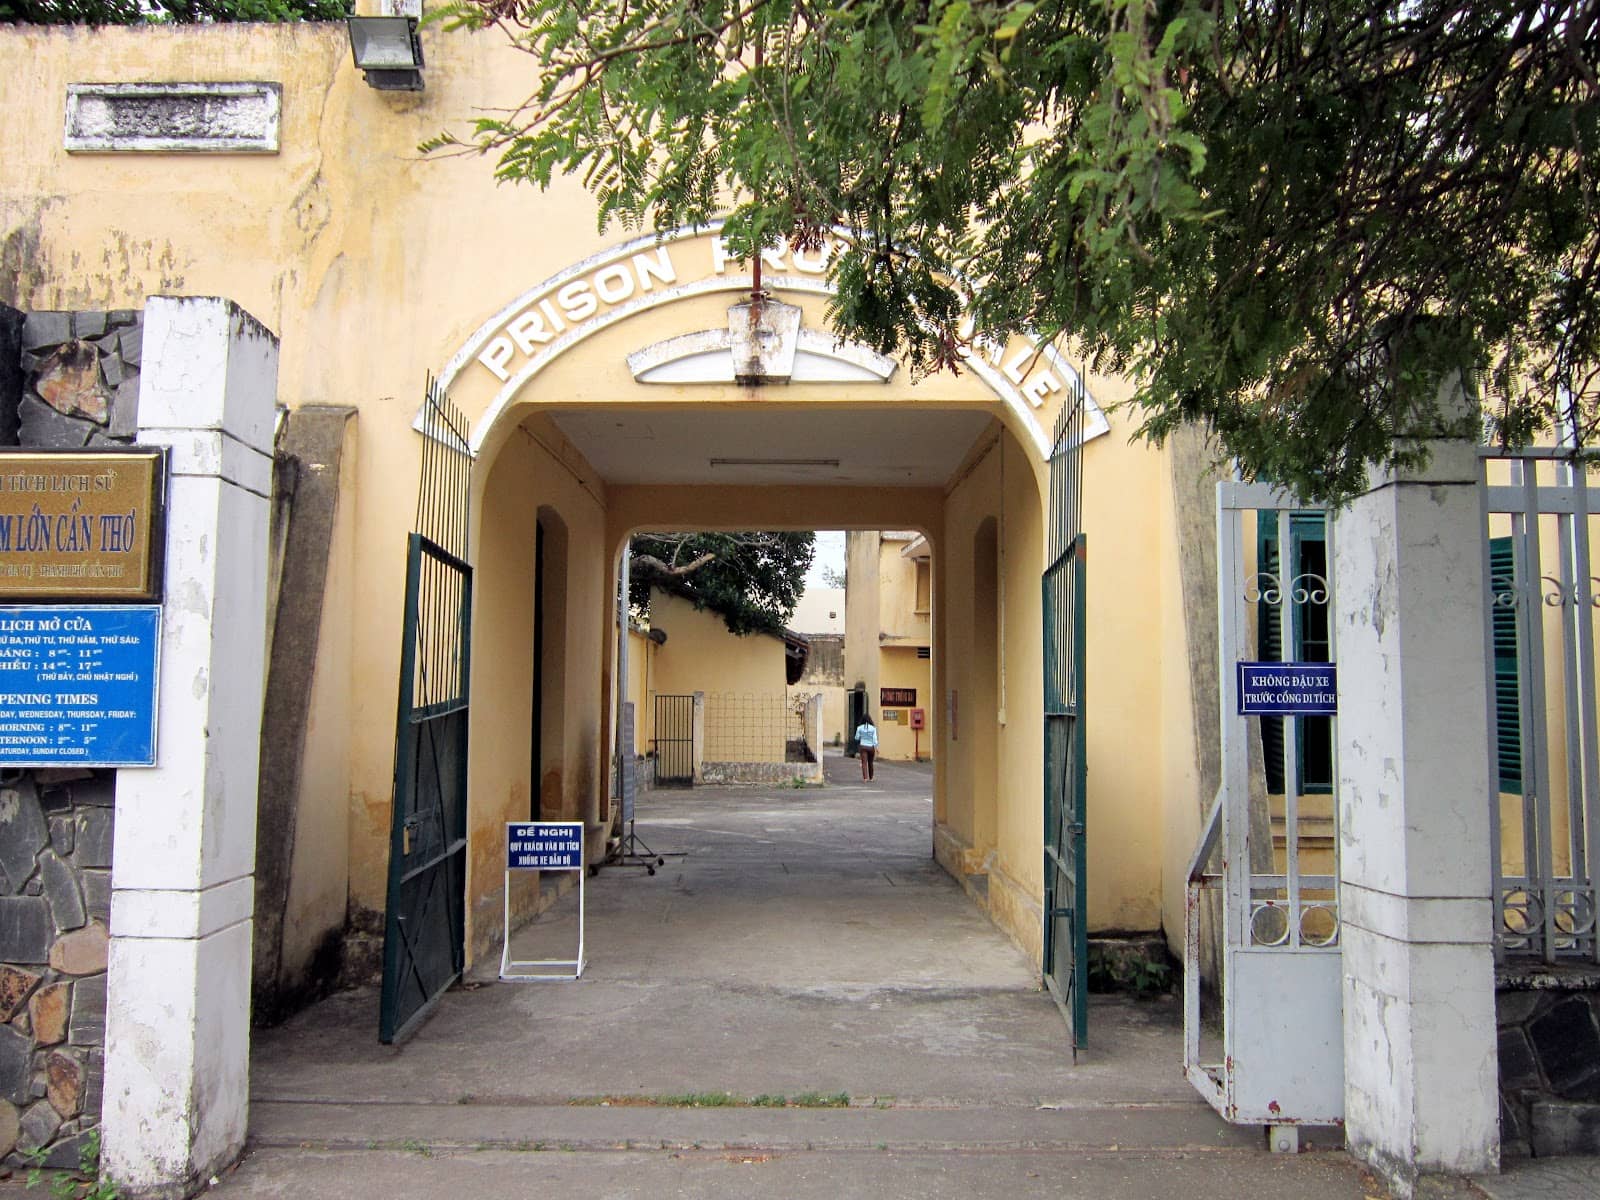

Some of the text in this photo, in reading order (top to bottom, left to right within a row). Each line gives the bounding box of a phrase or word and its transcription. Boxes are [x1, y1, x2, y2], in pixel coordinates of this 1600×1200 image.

[477, 246, 677, 382] PRISON
[51, 474, 89, 496] LỊCH
[16, 502, 52, 552] LỚN
[100, 508, 136, 552] THƠ
[1, 616, 92, 633] LỊCH MỞ CỬA
[1252, 674, 1330, 689] KHÔNG ĐẬU XE
[0, 693, 98, 705] PENING TIMES
[1245, 689, 1336, 704] TRƯỚC CỔNG DI TÍCH
[67, 710, 106, 719] THURSDAY,
[0, 736, 47, 745] TERNOON
[538, 828, 573, 838] NGHỊ
